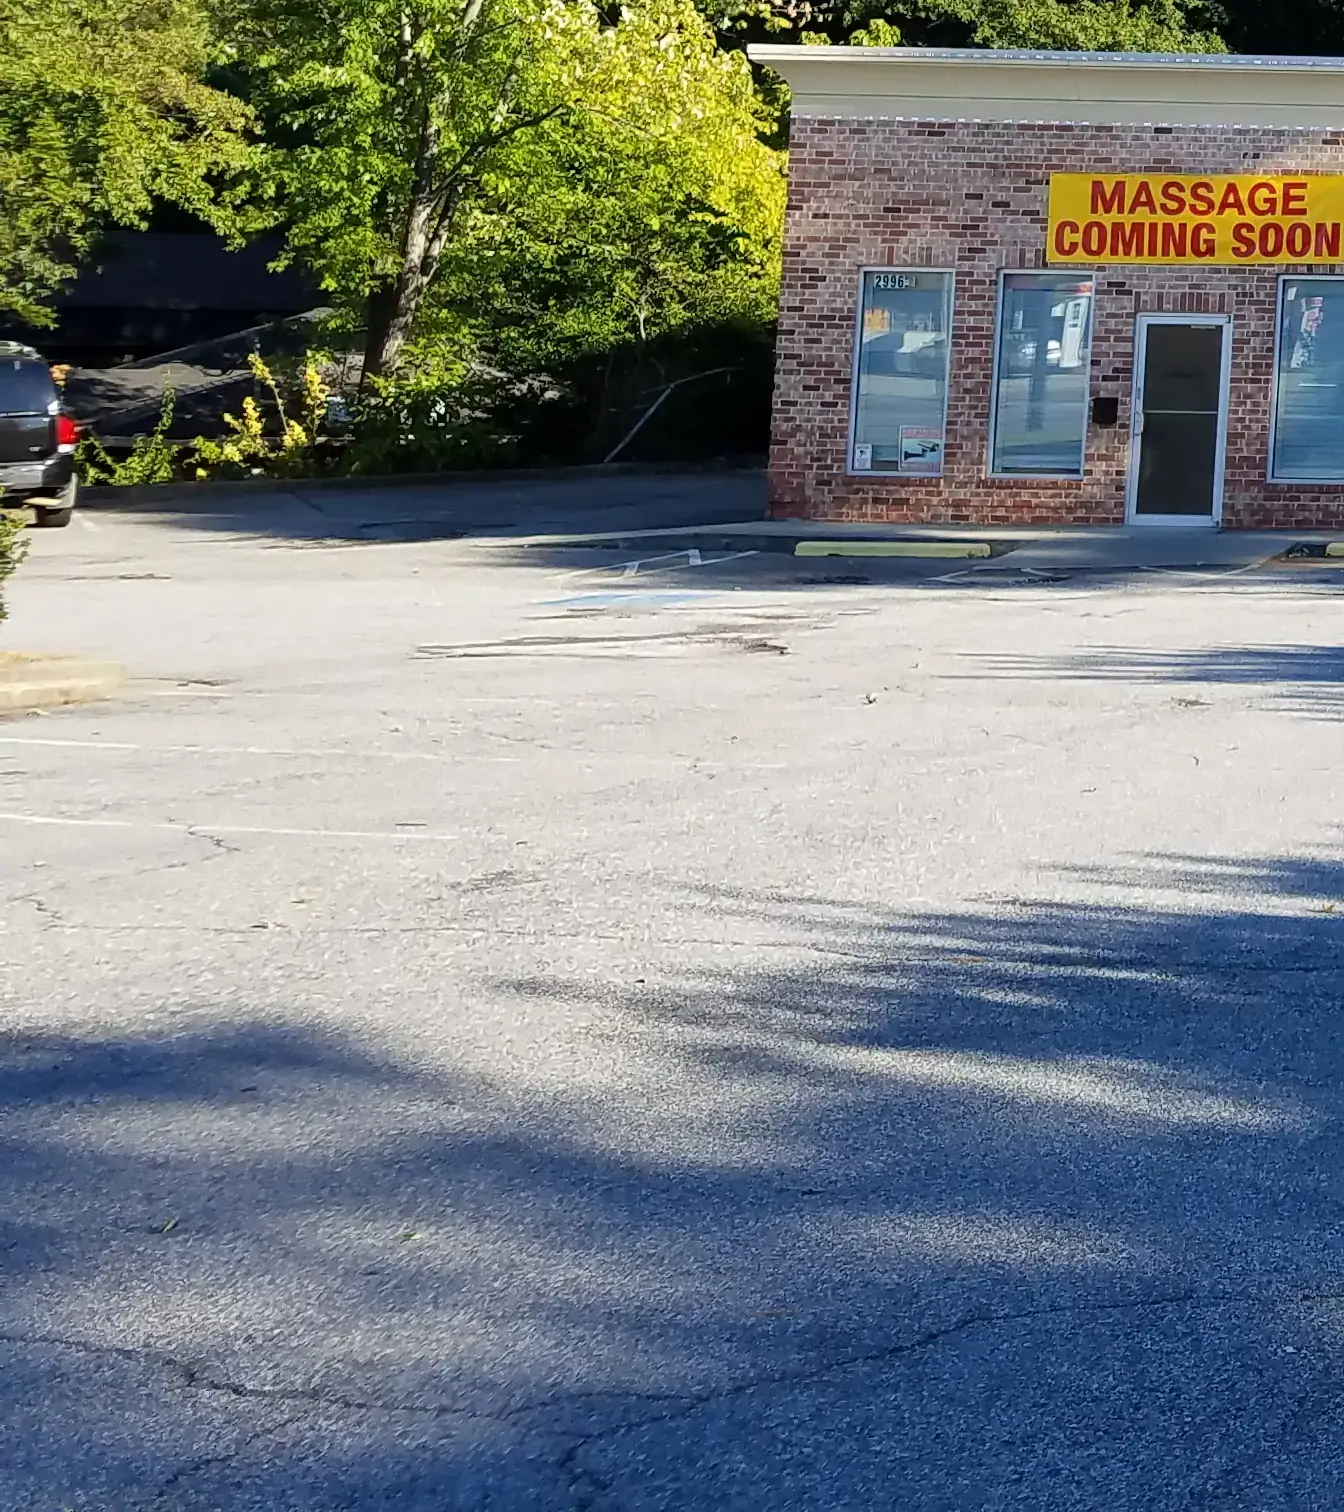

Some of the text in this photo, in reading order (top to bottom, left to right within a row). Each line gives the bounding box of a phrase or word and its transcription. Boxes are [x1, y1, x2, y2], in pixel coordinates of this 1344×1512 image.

[1089, 180, 1308, 217] MASSAGE
[1054, 220, 1341, 259] COMING SOON
[875, 275, 904, 288] 2996
